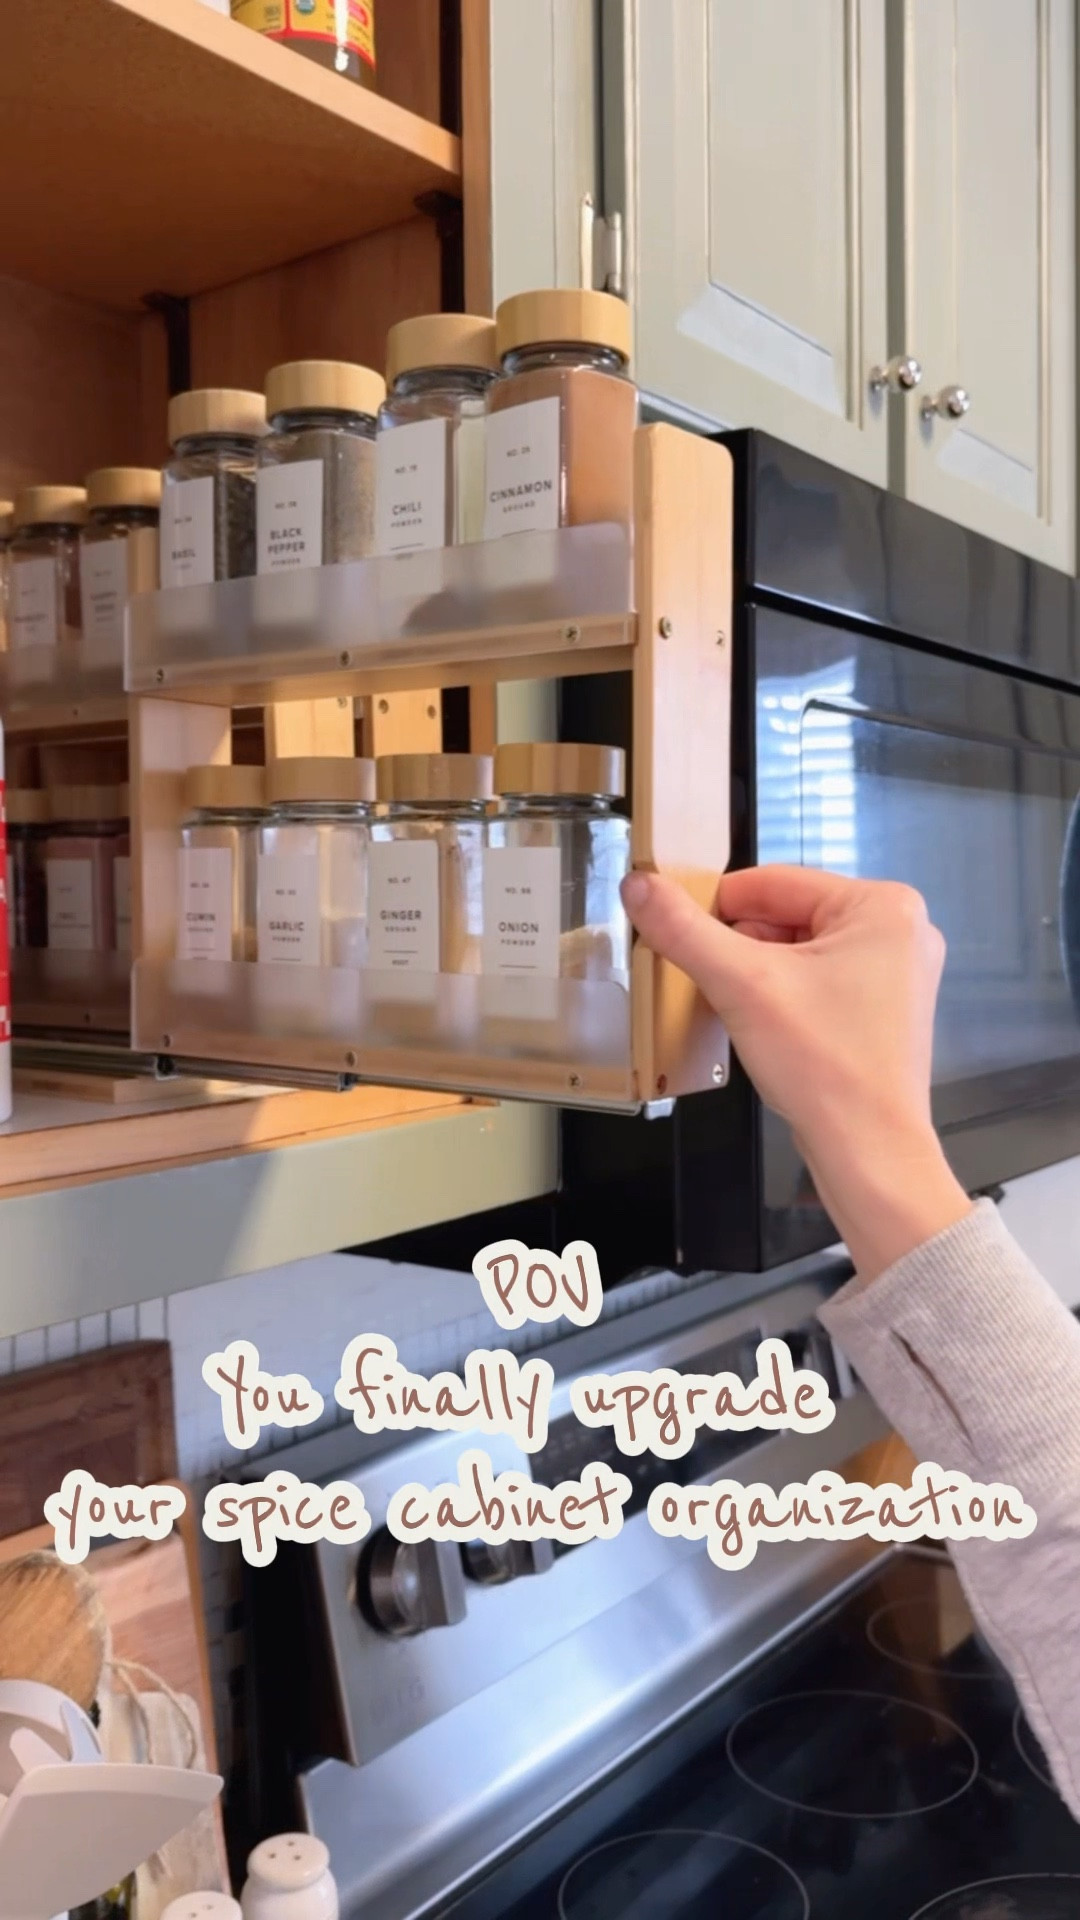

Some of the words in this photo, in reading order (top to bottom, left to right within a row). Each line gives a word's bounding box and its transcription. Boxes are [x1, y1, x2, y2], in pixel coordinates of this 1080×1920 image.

[489, 480, 553, 503] CINNAMON
[391, 501, 422, 516] CHILI
[502, 501, 536, 514] GROUND
[390, 518, 422, 528] POWDER
[269, 527, 303, 541] BLACK
[171, 548, 197, 561] BASIL
[267, 541, 306, 555] PEPPER
[186, 912, 216, 921] CUMIN
[380, 910, 422, 921] GINGER
[269, 921, 305, 931] GARLIC
[498, 922, 540, 934] ONION
